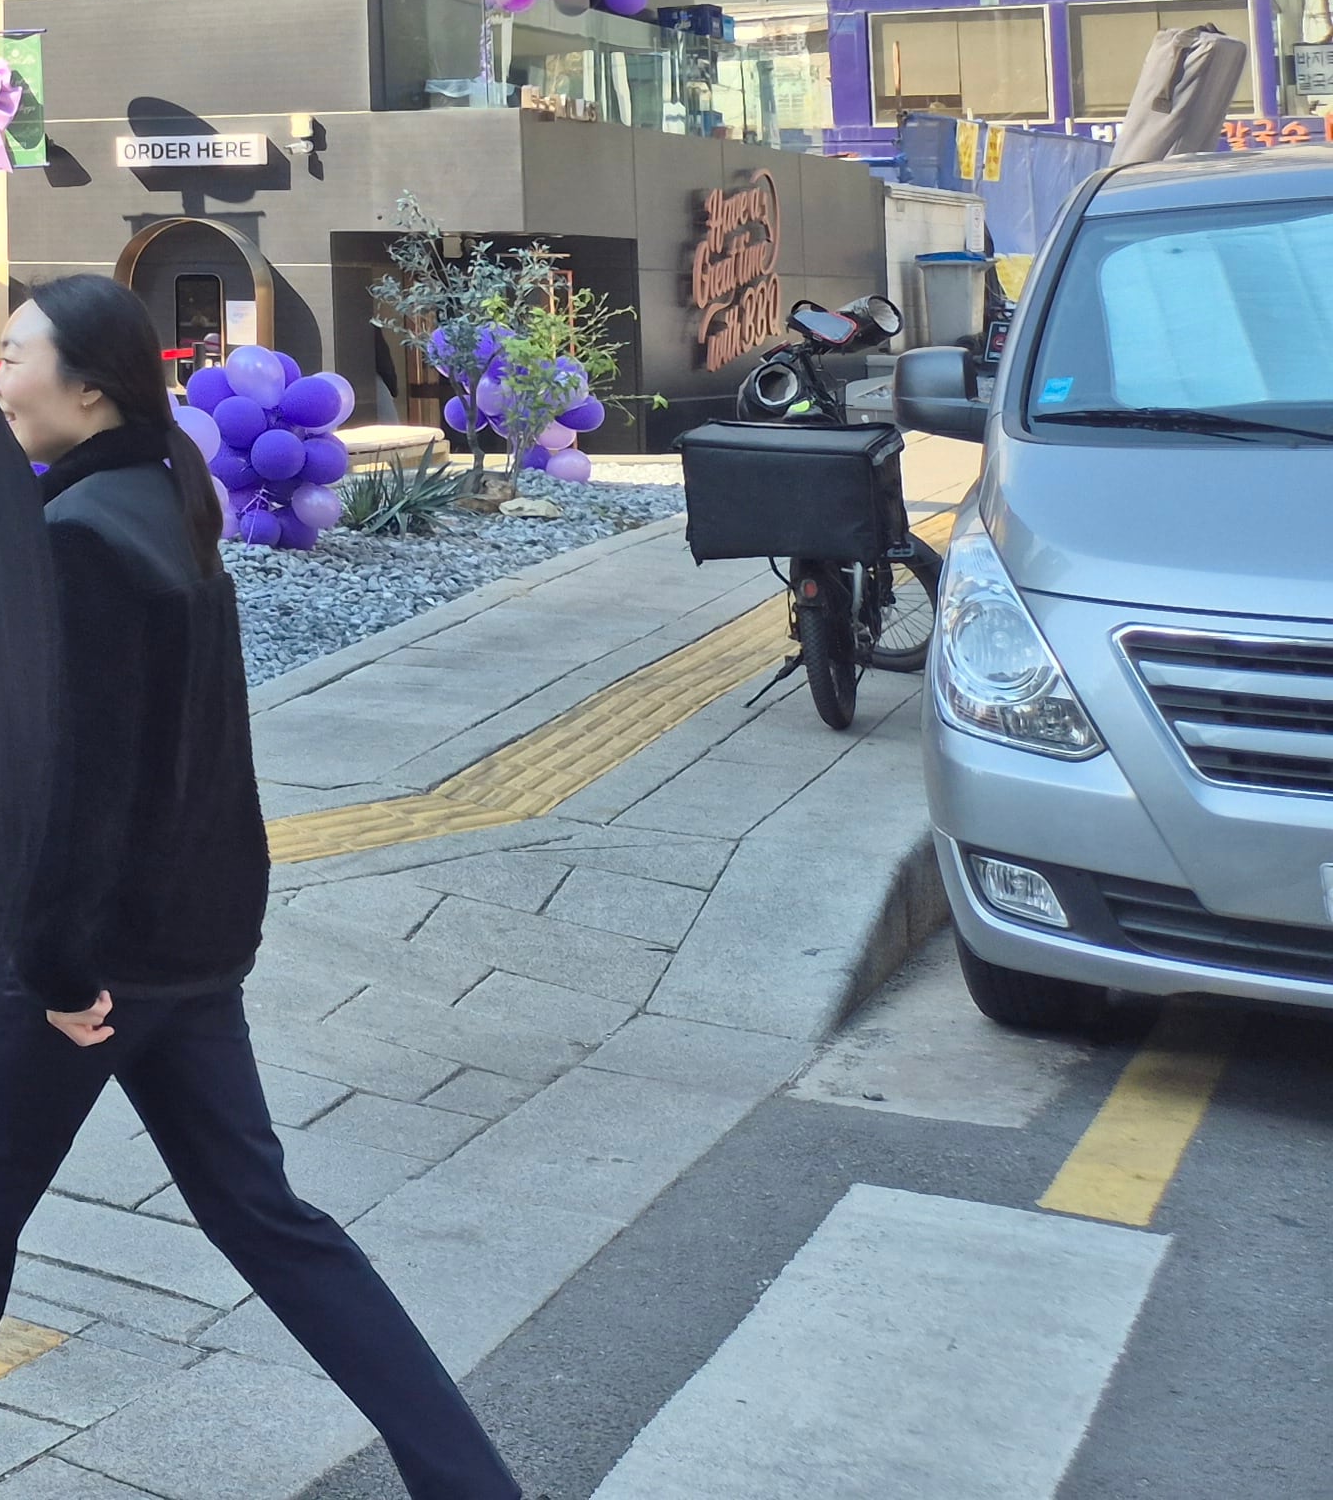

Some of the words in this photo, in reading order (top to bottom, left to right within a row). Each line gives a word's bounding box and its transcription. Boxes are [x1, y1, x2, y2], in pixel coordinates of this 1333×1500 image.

[124, 142, 191, 160] ORDER
[196, 141, 252, 159] HERE
[740, 273, 781, 352] BBQ
